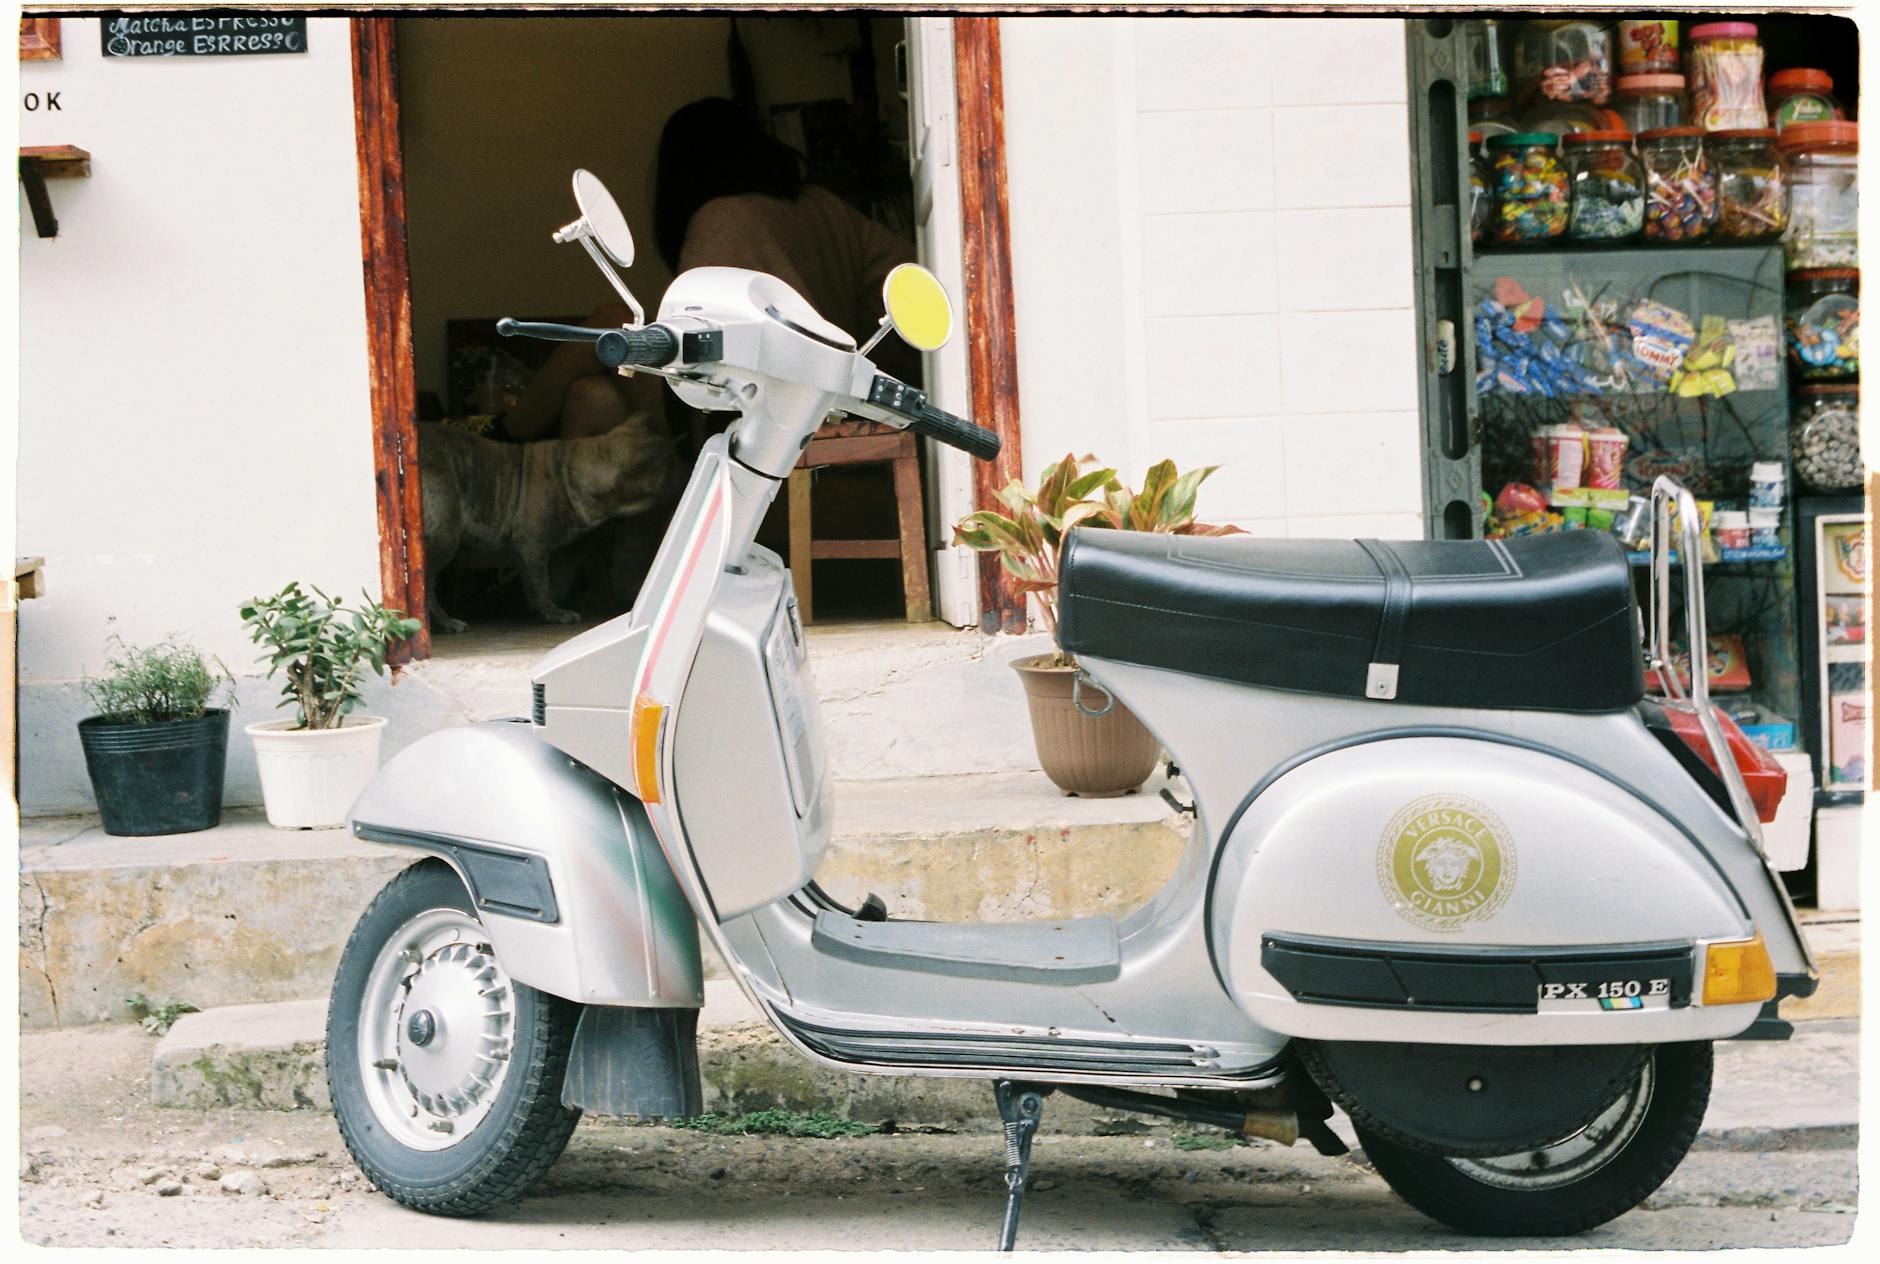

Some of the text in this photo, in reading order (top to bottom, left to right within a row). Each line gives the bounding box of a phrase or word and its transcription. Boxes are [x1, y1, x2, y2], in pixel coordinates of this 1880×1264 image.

[109, 17, 188, 33] Matcha
[108, 36, 187, 56] Orange
[1405, 810, 1488, 838] VERSACE
[1410, 890, 1486, 915] GIANNI
[1543, 978, 1669, 999] PX 150 E
